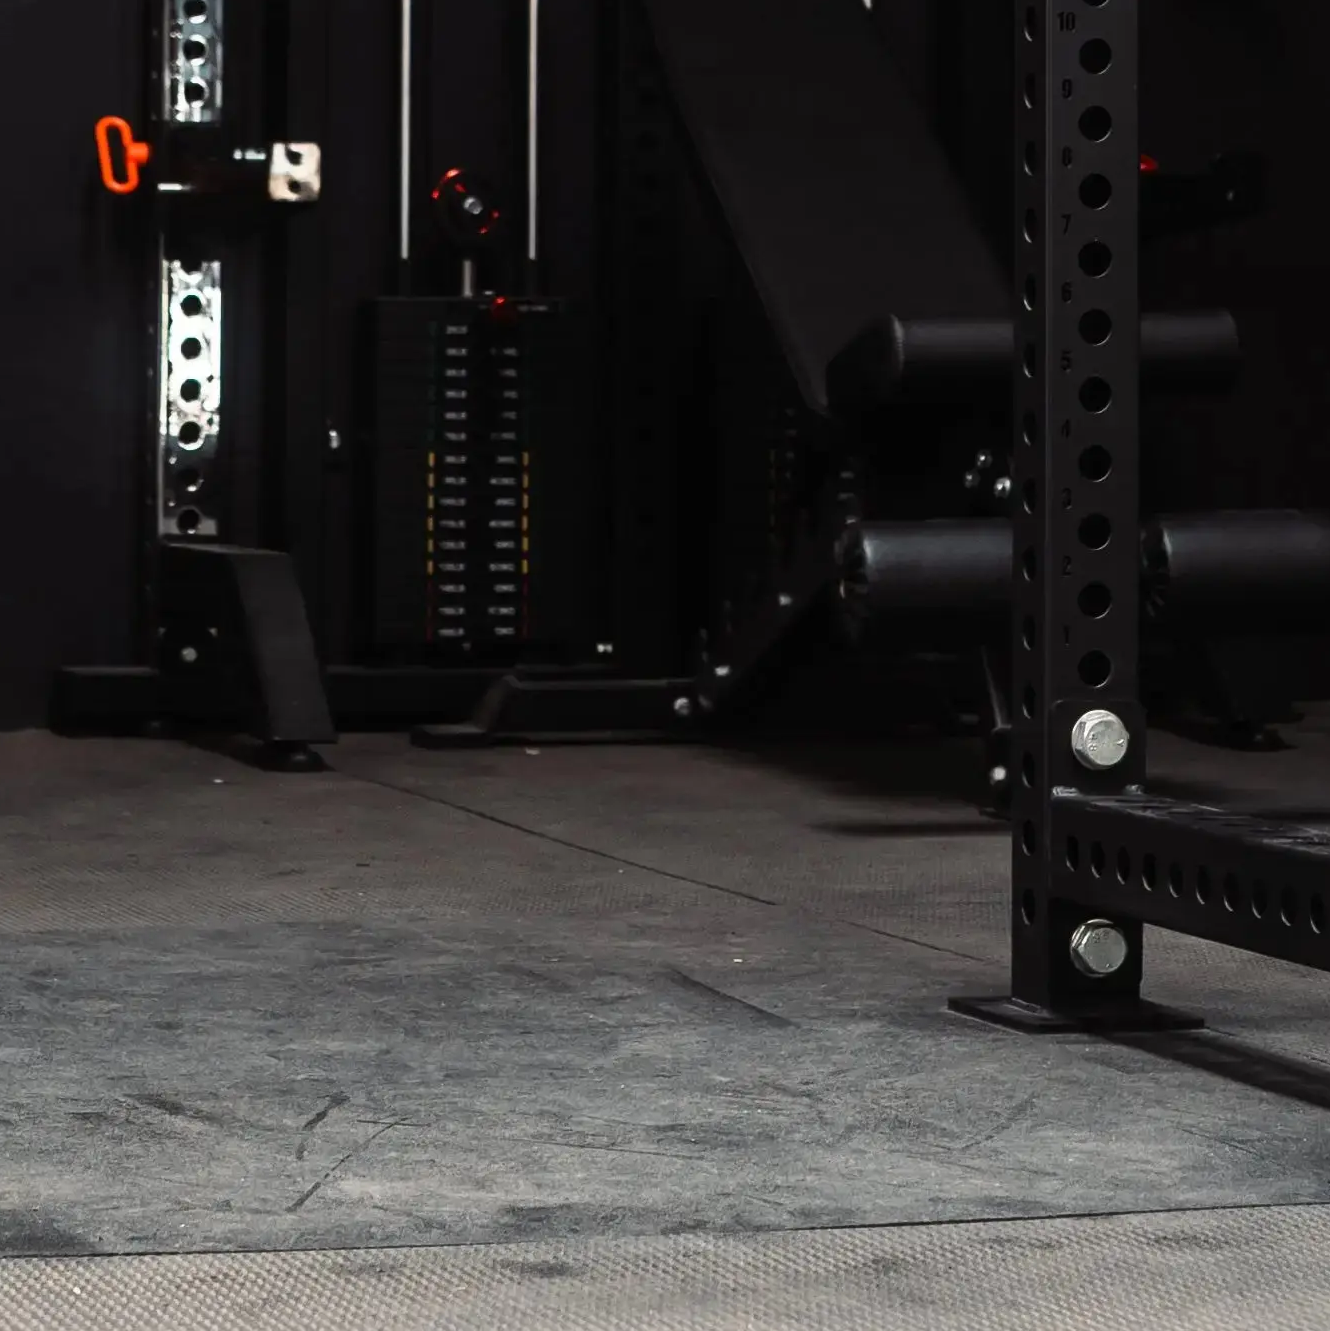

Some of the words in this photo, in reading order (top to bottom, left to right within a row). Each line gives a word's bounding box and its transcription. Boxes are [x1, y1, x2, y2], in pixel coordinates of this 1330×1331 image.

[1057, 11, 1076, 32] 10
[1061, 78, 1073, 100] 9
[1060, 213, 1072, 236] 7
[1060, 281, 1073, 303] 6
[1060, 350, 1072, 372] 5
